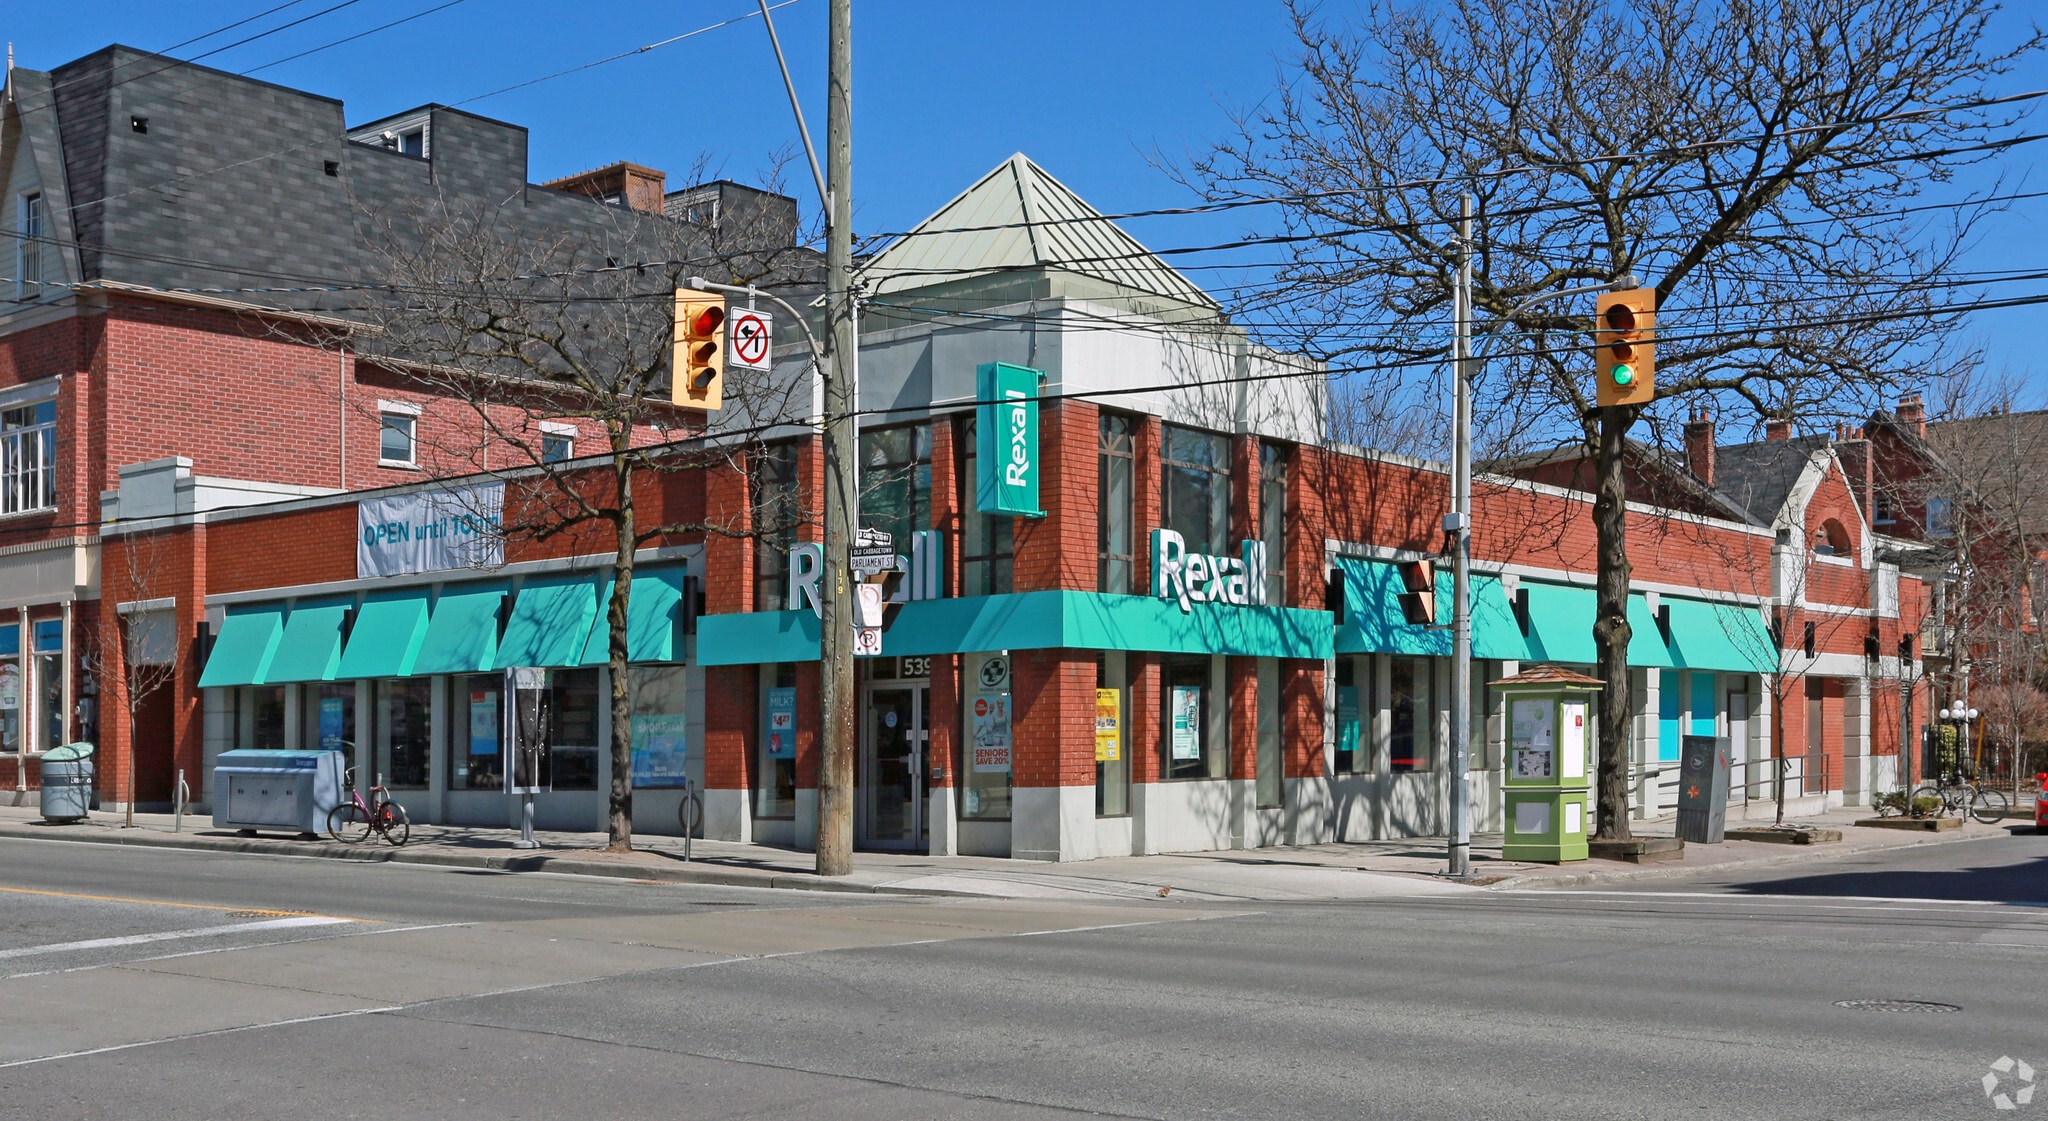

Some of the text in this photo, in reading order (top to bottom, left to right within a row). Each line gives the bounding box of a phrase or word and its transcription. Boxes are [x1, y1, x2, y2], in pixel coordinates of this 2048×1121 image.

[1006, 389, 1029, 487] Rexall
[364, 513, 498, 547] OPEN until 10pm
[851, 556, 893, 569] PARLIAMENT ST
[1156, 528, 1267, 614] Rexall
[975, 748, 1009, 758] SENIORS
[975, 757, 1009, 766] SAVE 20%
